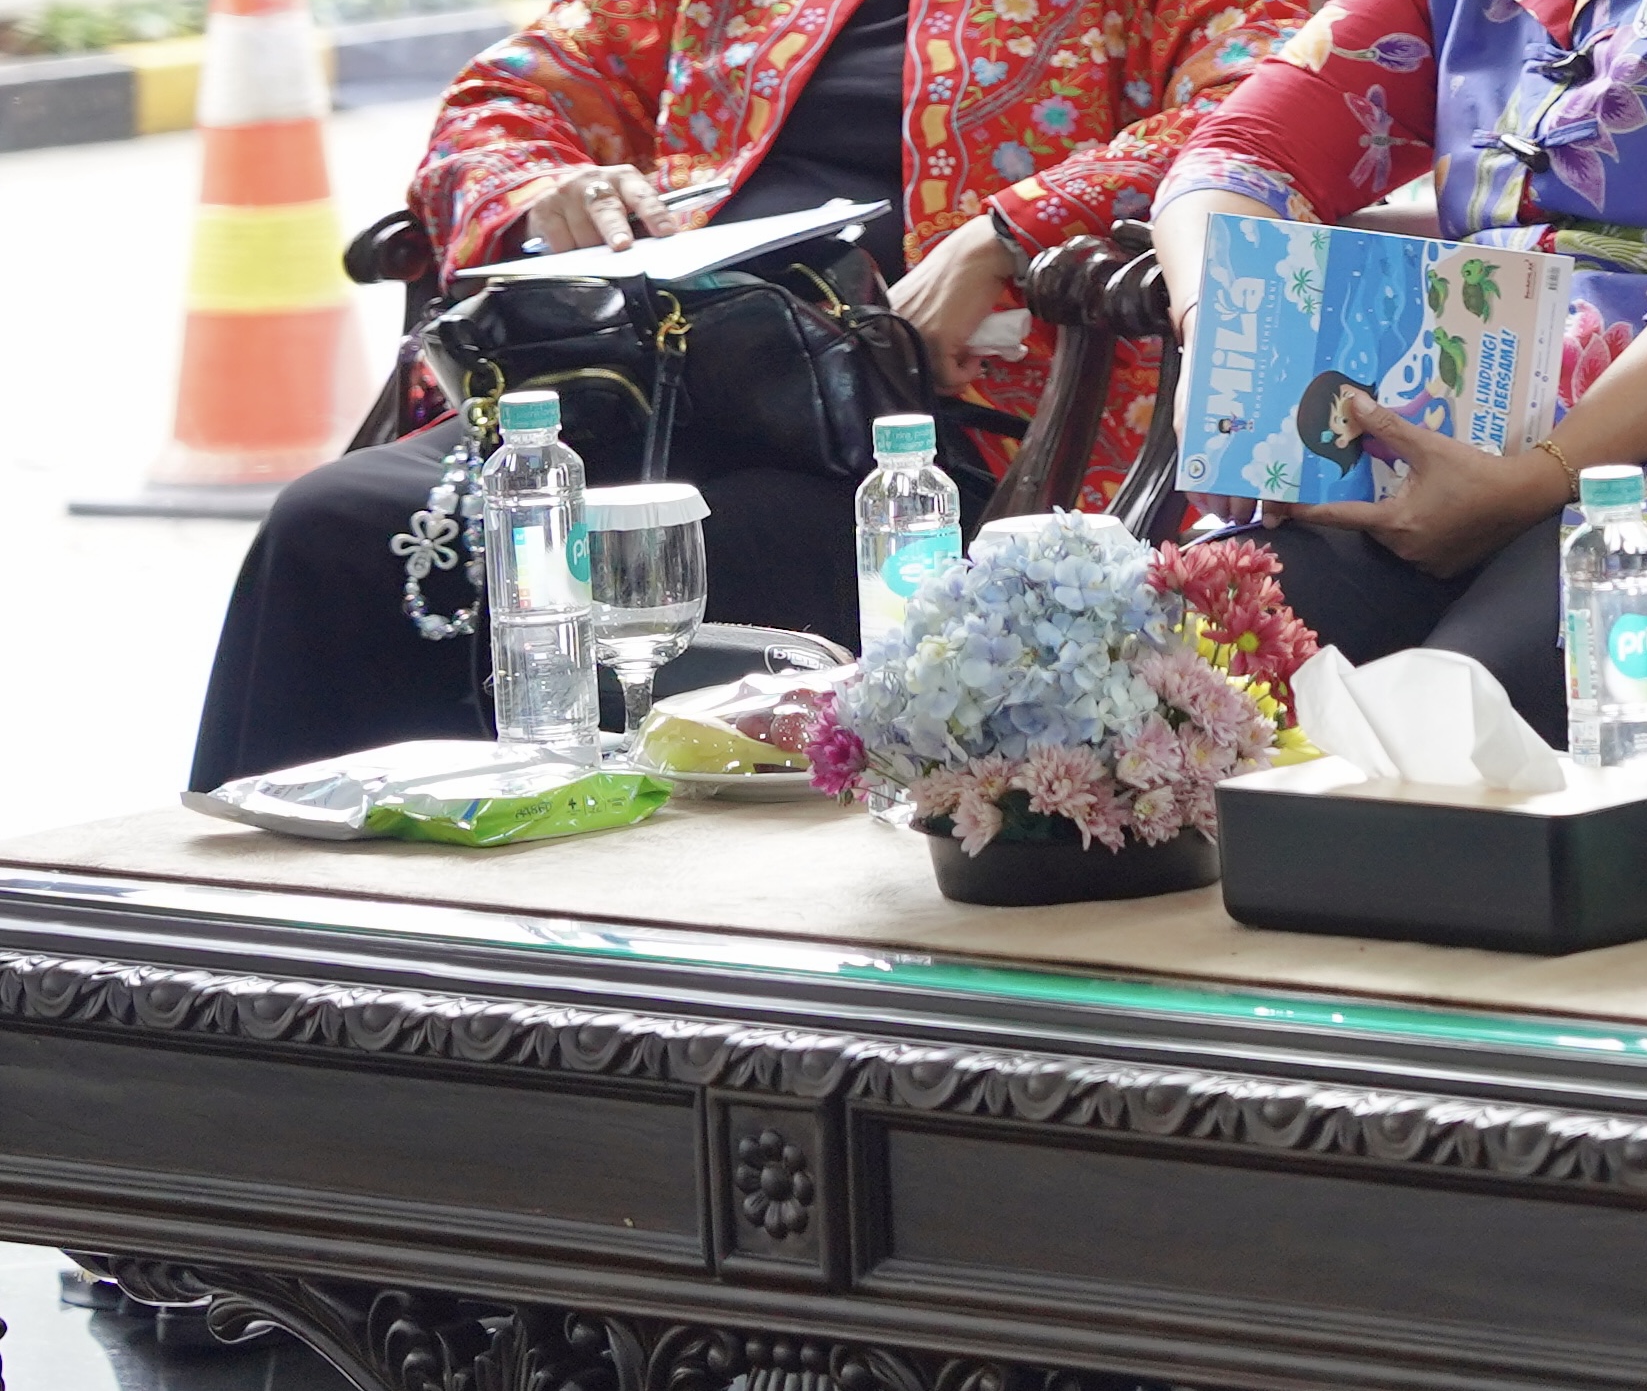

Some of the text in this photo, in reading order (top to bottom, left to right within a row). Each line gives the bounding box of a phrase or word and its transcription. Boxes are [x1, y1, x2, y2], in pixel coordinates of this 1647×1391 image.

[1471, 333, 1497, 442] YUK, LINDUNGI
[1489, 329, 1517, 450] AUT BERSAMA!
